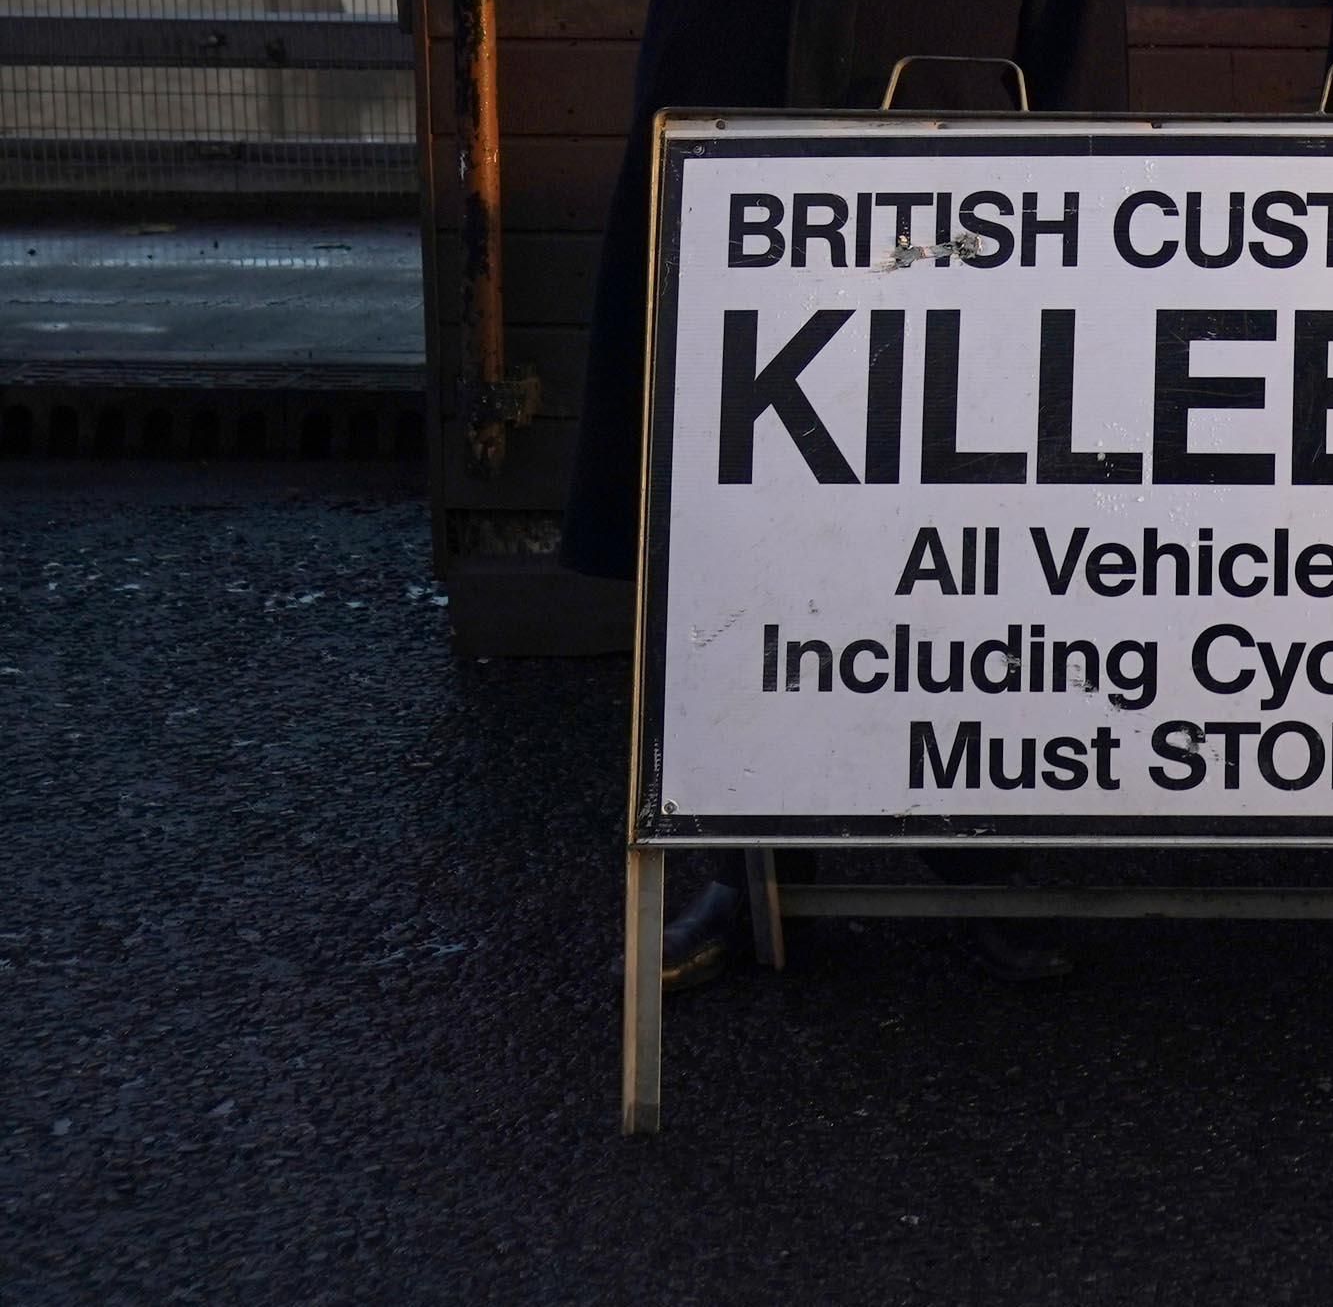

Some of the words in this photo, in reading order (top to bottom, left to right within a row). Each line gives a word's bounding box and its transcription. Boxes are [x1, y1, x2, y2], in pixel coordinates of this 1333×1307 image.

[726, 191, 1080, 270] BRITISH
[894, 525, 999, 596] All
[762, 624, 1158, 711] Including
[908, 720, 1121, 790] Must
